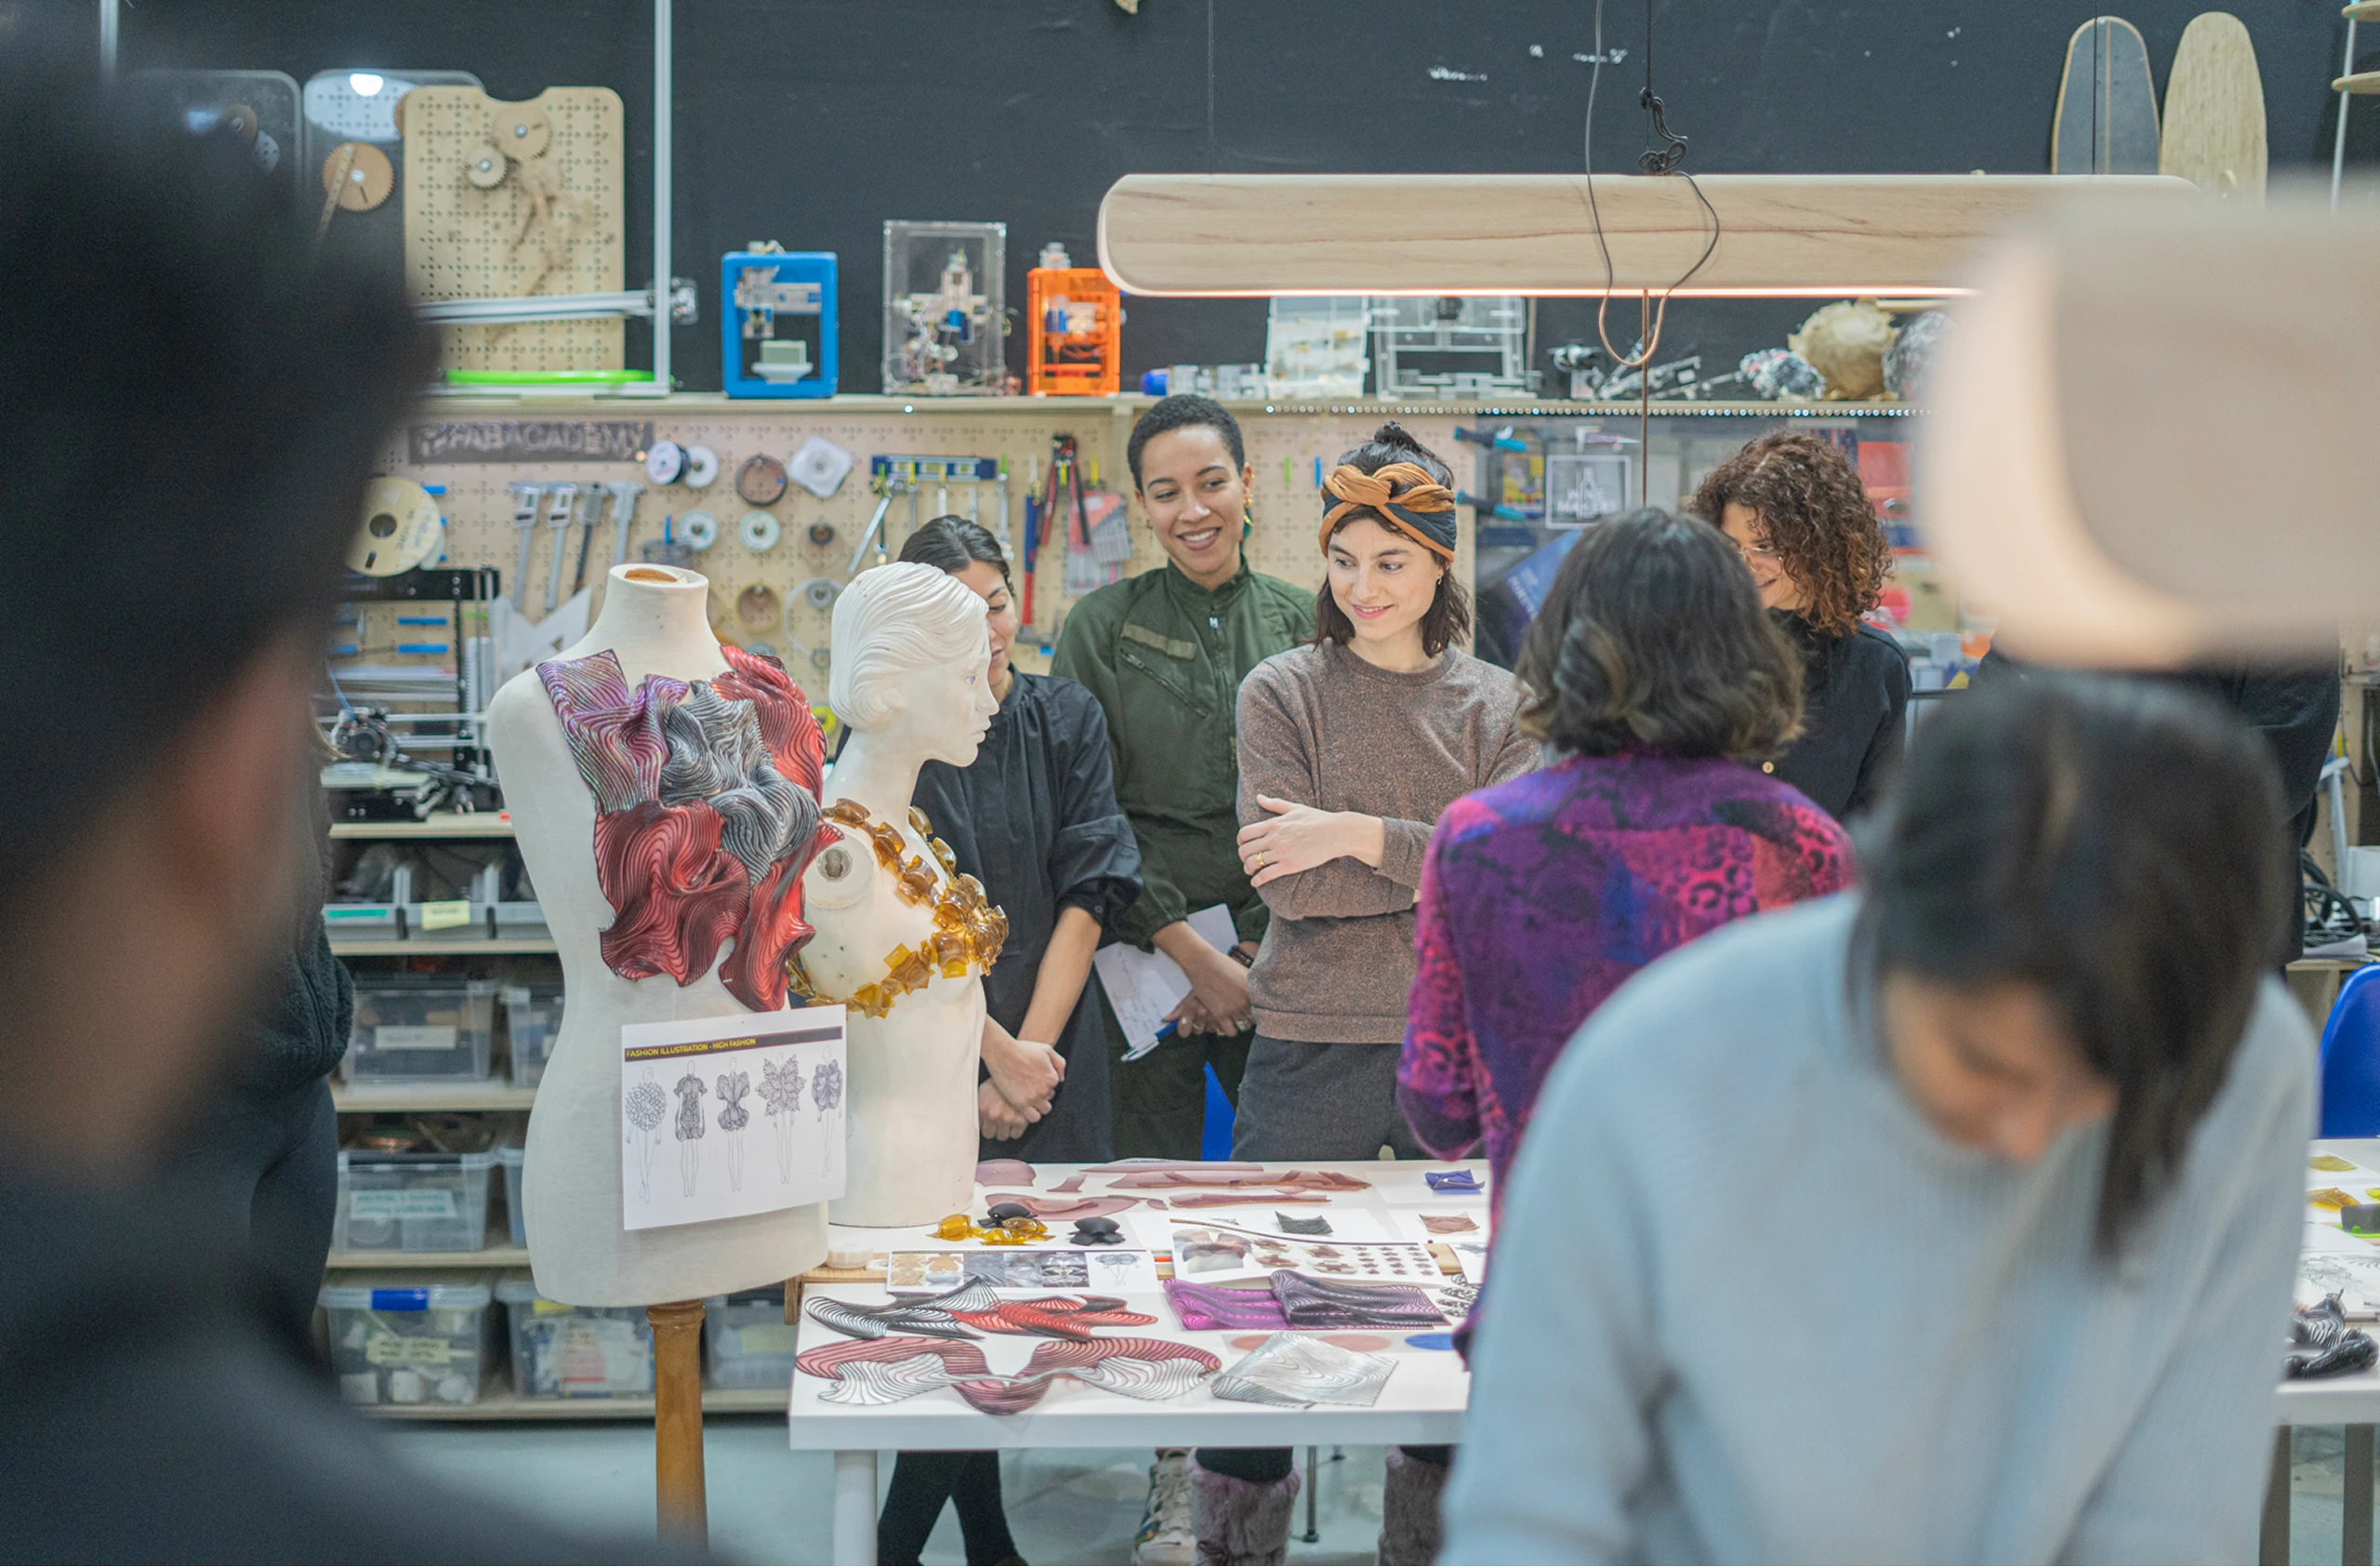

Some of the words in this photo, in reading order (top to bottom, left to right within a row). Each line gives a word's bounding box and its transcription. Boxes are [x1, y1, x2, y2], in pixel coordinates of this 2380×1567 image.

[626, 1047, 659, 1058] FASHION
[659, 1042, 708, 1056] ILLUSTRATION
[712, 1042, 729, 1050] HIGH
[729, 1037, 757, 1047] FASHION
